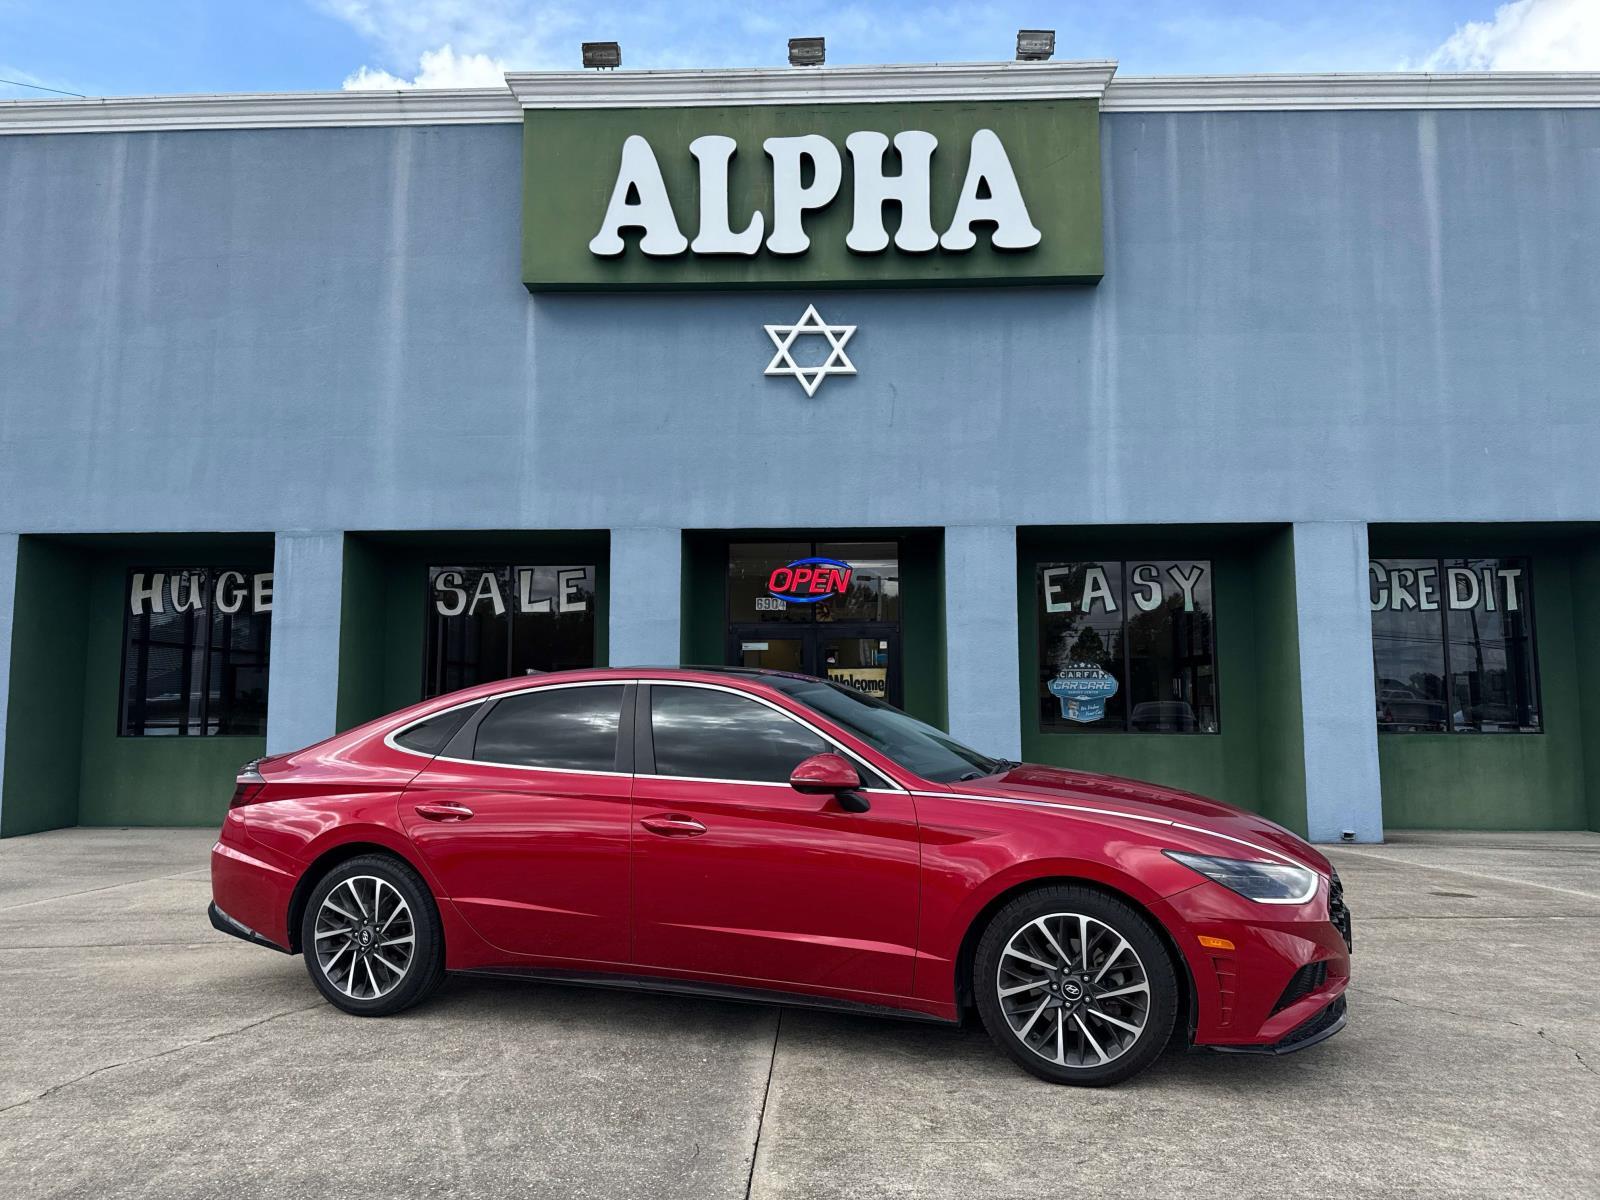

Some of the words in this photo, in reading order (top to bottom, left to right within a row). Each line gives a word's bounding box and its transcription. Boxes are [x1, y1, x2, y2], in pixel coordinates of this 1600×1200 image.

[589, 128, 1042, 256] ALPHA
[130, 570, 273, 615] HUGE
[434, 568, 587, 616] SALE
[768, 566, 852, 593] OPEN
[1043, 565, 1204, 614] EASY
[1369, 561, 1522, 612] CREDIT
[756, 598, 786, 610] 6904
[1059, 670, 1108, 679] CARFAX
